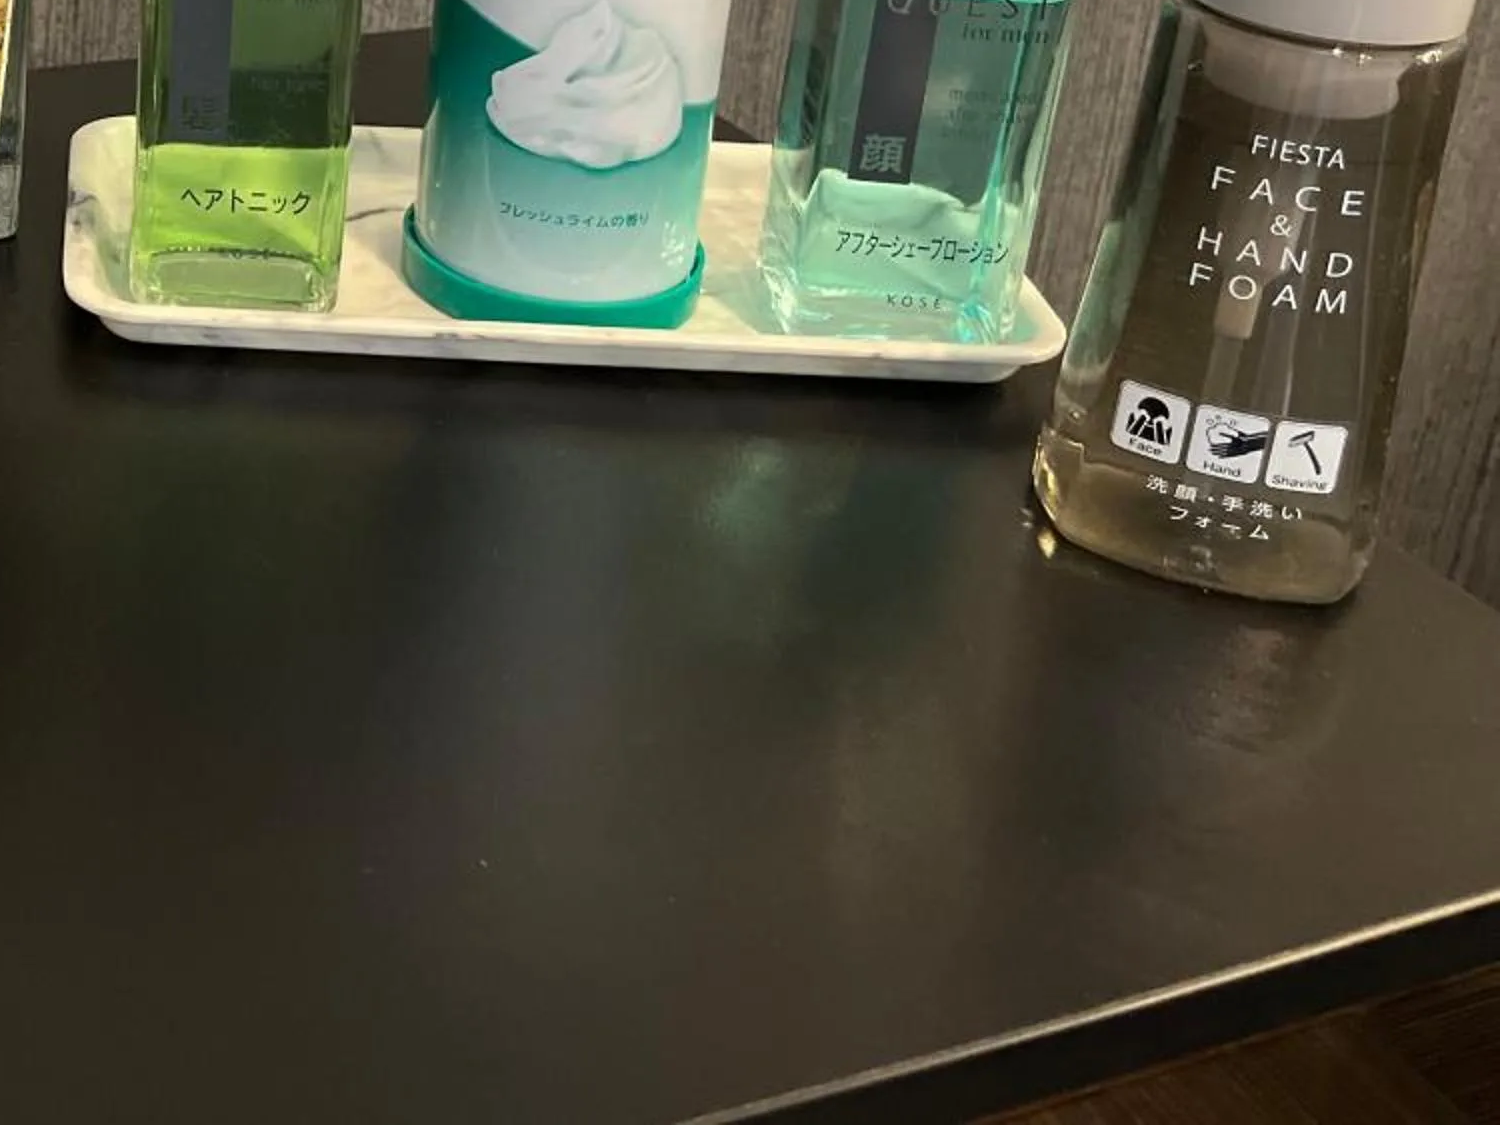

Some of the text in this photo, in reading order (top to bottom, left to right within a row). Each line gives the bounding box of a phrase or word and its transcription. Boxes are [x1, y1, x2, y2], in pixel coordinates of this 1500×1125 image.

[962, 23, 992, 43] for
[860, 134, 906, 173] 顔
[1251, 134, 1346, 170] FIESTA
[181, 188, 312, 215] ヘアトニック
[1211, 166, 1365, 217] FACE
[500, 201, 649, 229] フレッシュライムの香り
[1271, 213, 1294, 238] &
[835, 229, 1009, 265] アフターシェーブローション
[1197, 226, 1353, 278] HAND
[1189, 262, 1347, 315] FOAM
[1129, 437, 1163, 457] Face
[1203, 460, 1242, 478] Hand
[1146, 474, 1303, 521] 洗顔・手洗い
